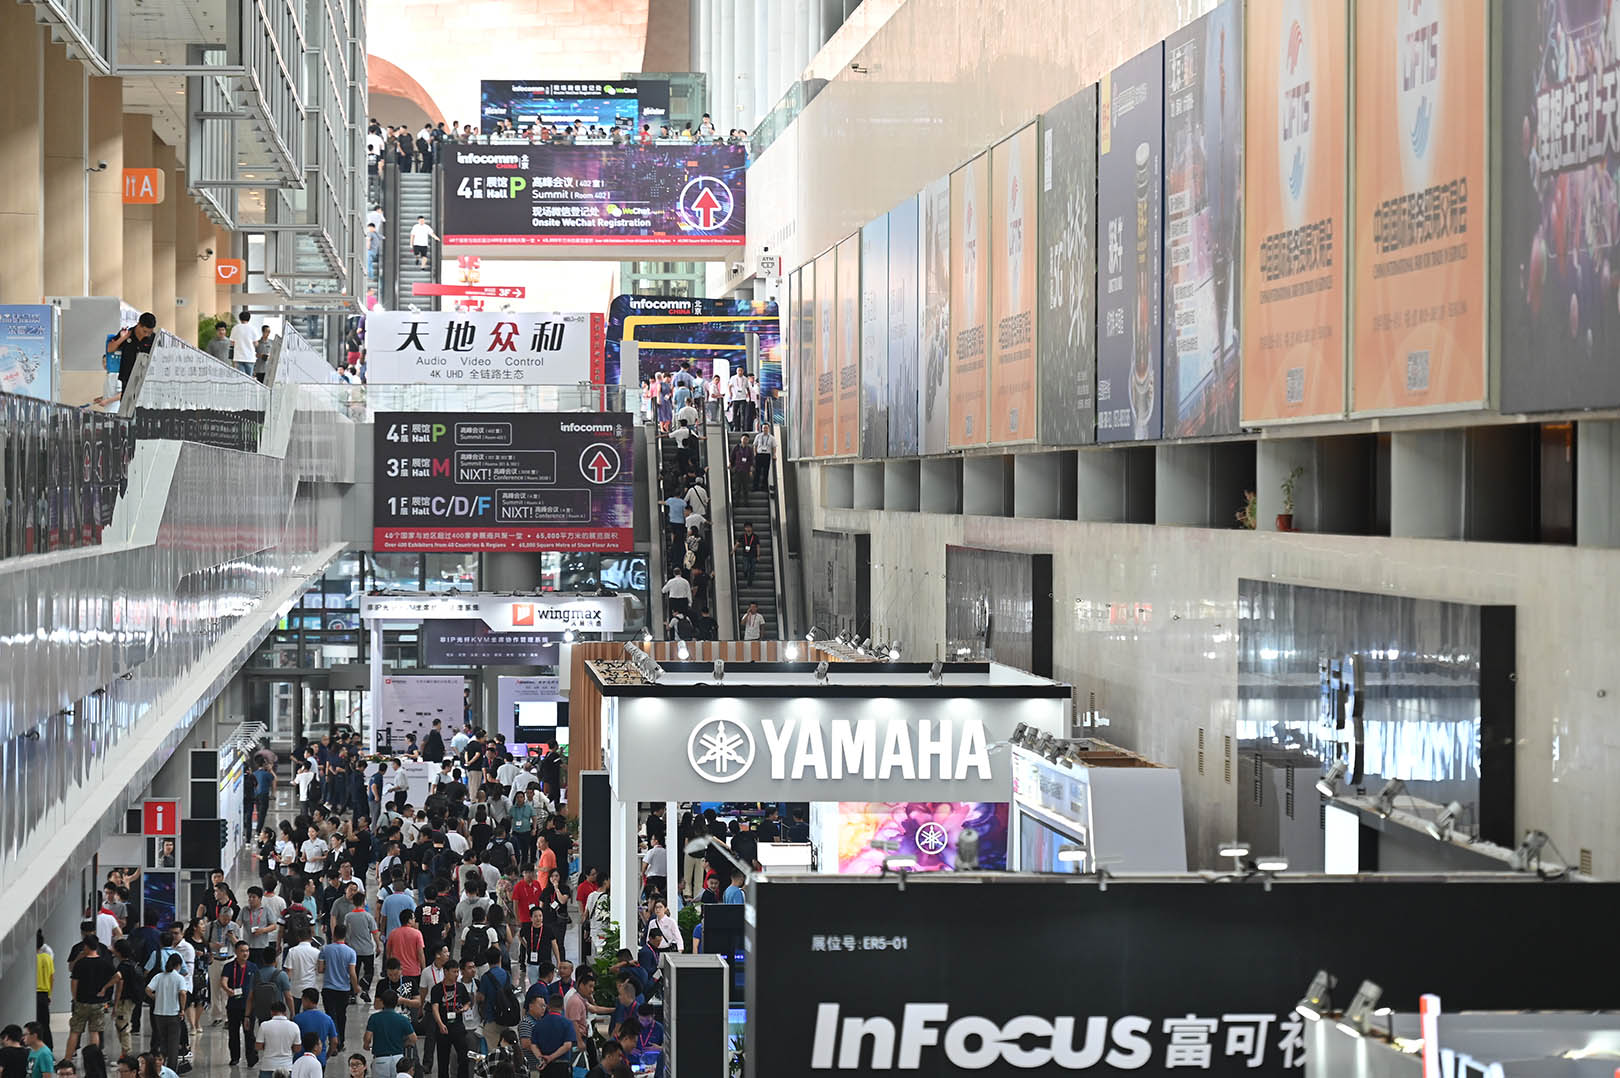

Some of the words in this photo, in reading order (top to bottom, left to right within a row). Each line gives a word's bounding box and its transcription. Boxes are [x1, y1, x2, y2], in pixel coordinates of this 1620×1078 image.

[1537, 67, 1620, 173] 理想生活上天
[457, 152, 518, 164] infocomm
[140, 175, 154, 197] A
[456, 177, 473, 198] 4
[473, 177, 482, 189] F
[486, 176, 509, 188] 展馆
[510, 176, 527, 198] P
[532, 176, 574, 188] 高峰会议
[486, 189, 508, 198] Hall
[532, 190, 569, 200] Summit
[532, 206, 600, 217] 现场微信登记处
[622, 207, 651, 215] WeChat
[532, 218, 561, 227] Onsite
[562, 218, 596, 227] WeChat
[597, 218, 652, 229] Registration
[498, 288, 511, 296] 3F
[630, 297, 691, 310] infocomm
[694, 300, 702, 315] 北京
[396, 321, 565, 352] 天地众和
[416, 357, 447, 366] Audio
[461, 357, 491, 366] Video
[504, 357, 544, 366] Control
[430, 370, 441, 378] 4K
[446, 370, 464, 378] UHD
[469, 369, 525, 380] 全链路生态
[401, 424, 408, 434] F
[412, 423, 431, 433] 展馆
[561, 422, 613, 432] infocomm
[386, 424, 400, 443] 4
[412, 434, 430, 442] Hall
[432, 424, 446, 442] P
[386, 459, 400, 477] 3
[401, 459, 408, 468] F
[412, 458, 431, 468] 展馆
[433, 458, 450, 477] M
[412, 469, 430, 477] Hall
[460, 469, 491, 480] NIXT!
[387, 497, 397, 515] 1
[401, 497, 408, 507] F
[411, 496, 431, 506] 展馆
[431, 495, 492, 517] C/D/F
[411, 507, 430, 515] Hall
[501, 507, 533, 518] NIXT!
[538, 607, 602, 622] wingmax
[761, 719, 993, 780] YAMAHA
